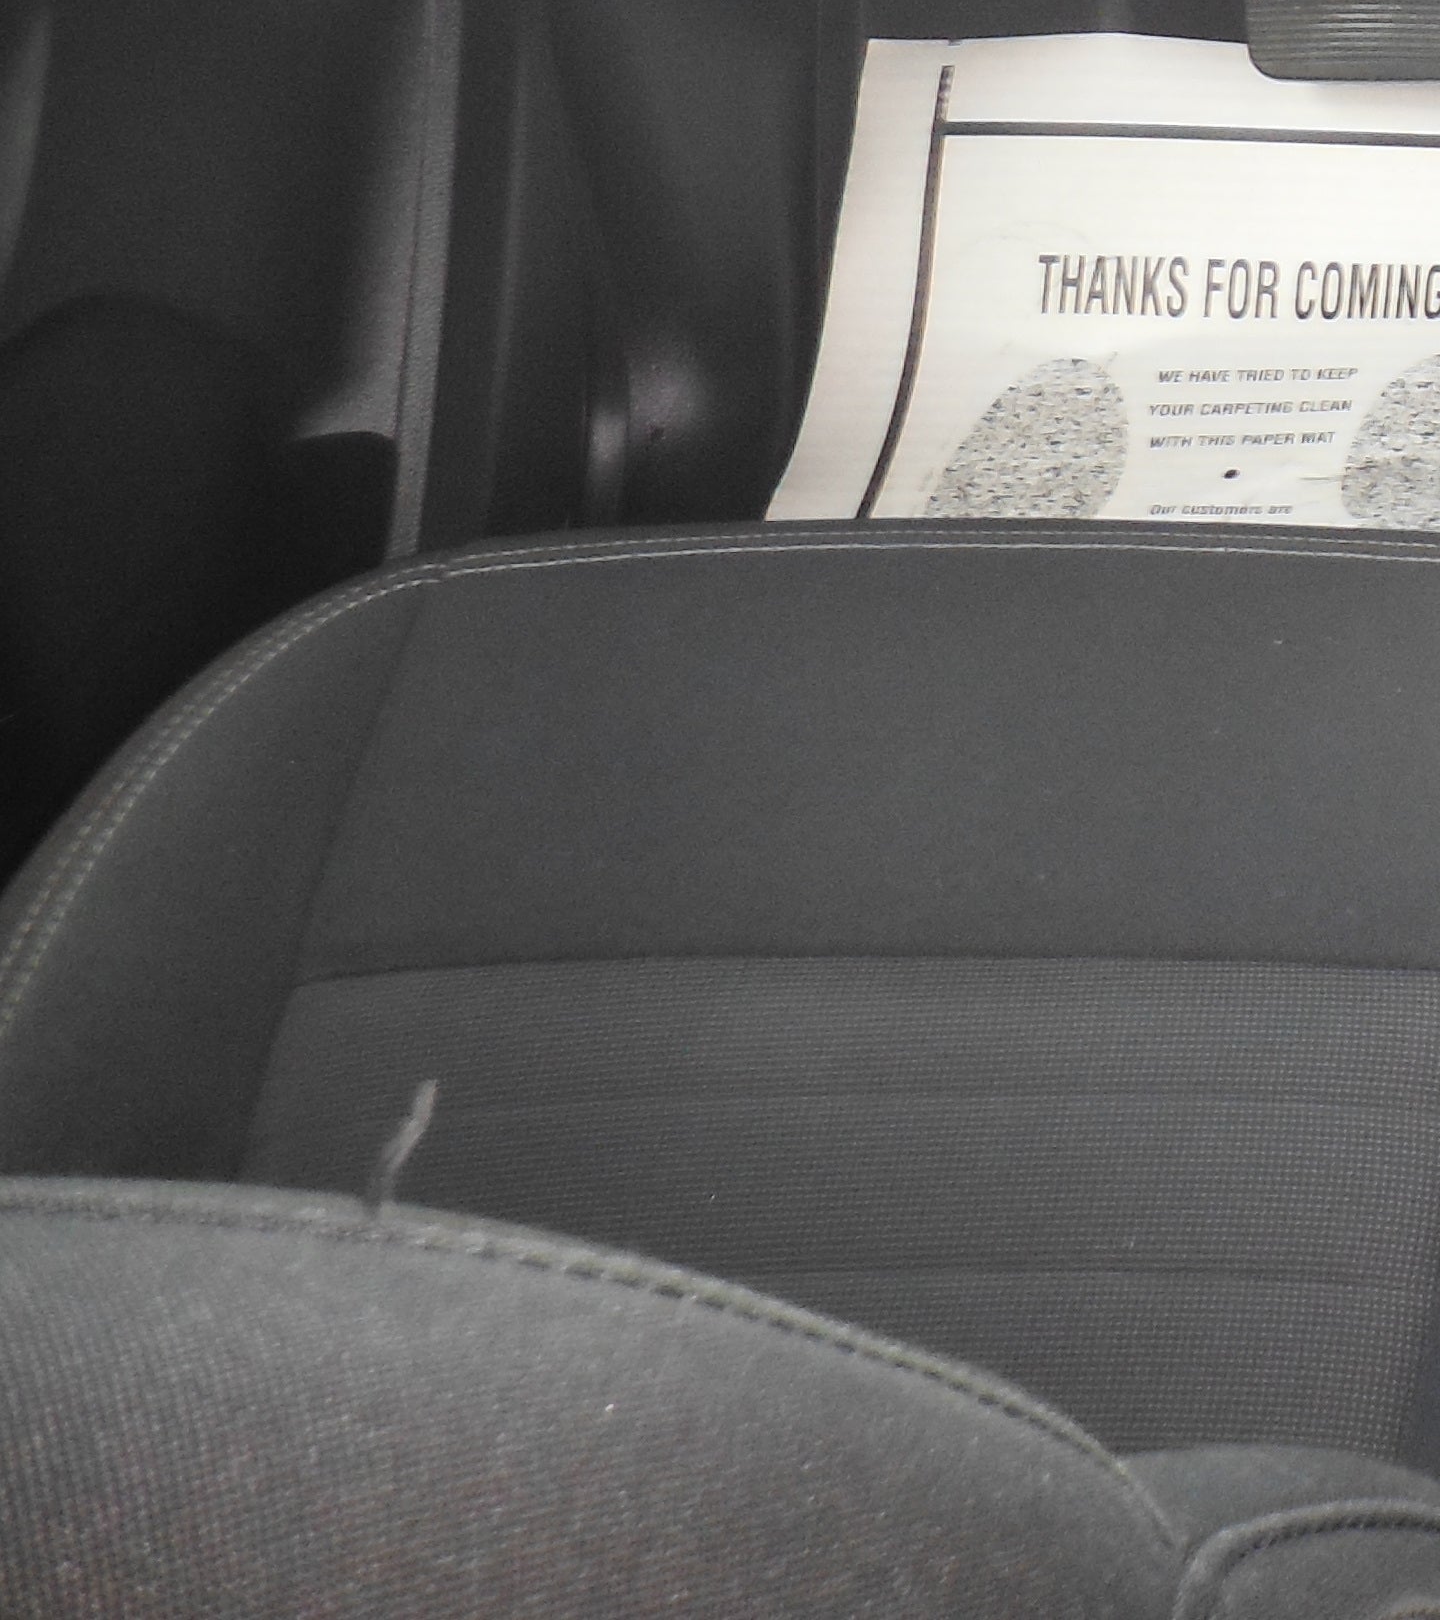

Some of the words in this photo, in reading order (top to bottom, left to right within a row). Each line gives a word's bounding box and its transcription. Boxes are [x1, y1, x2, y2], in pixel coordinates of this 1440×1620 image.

[1038, 254, 1190, 318] THANKS
[1204, 258, 1280, 320] FOR
[1158, 370, 1183, 383] WE
[1189, 369, 1230, 383] HAVE
[1238, 368, 1284, 382] TRIED
[1292, 368, 1311, 381] TO
[1316, 367, 1358, 380] KEEP
[1149, 403, 1194, 416] YOUR
[1200, 401, 1294, 416] CARPETING
[1300, 400, 1352, 413] CLEAN
[1150, 435, 1192, 448] WITH
[1200, 434, 1235, 447] THIS
[1241, 433, 1295, 446] PAPER
[1301, 431, 1335, 445] MAT
[1150, 504, 1176, 516] Our
[1181, 505, 1263, 516] customers
